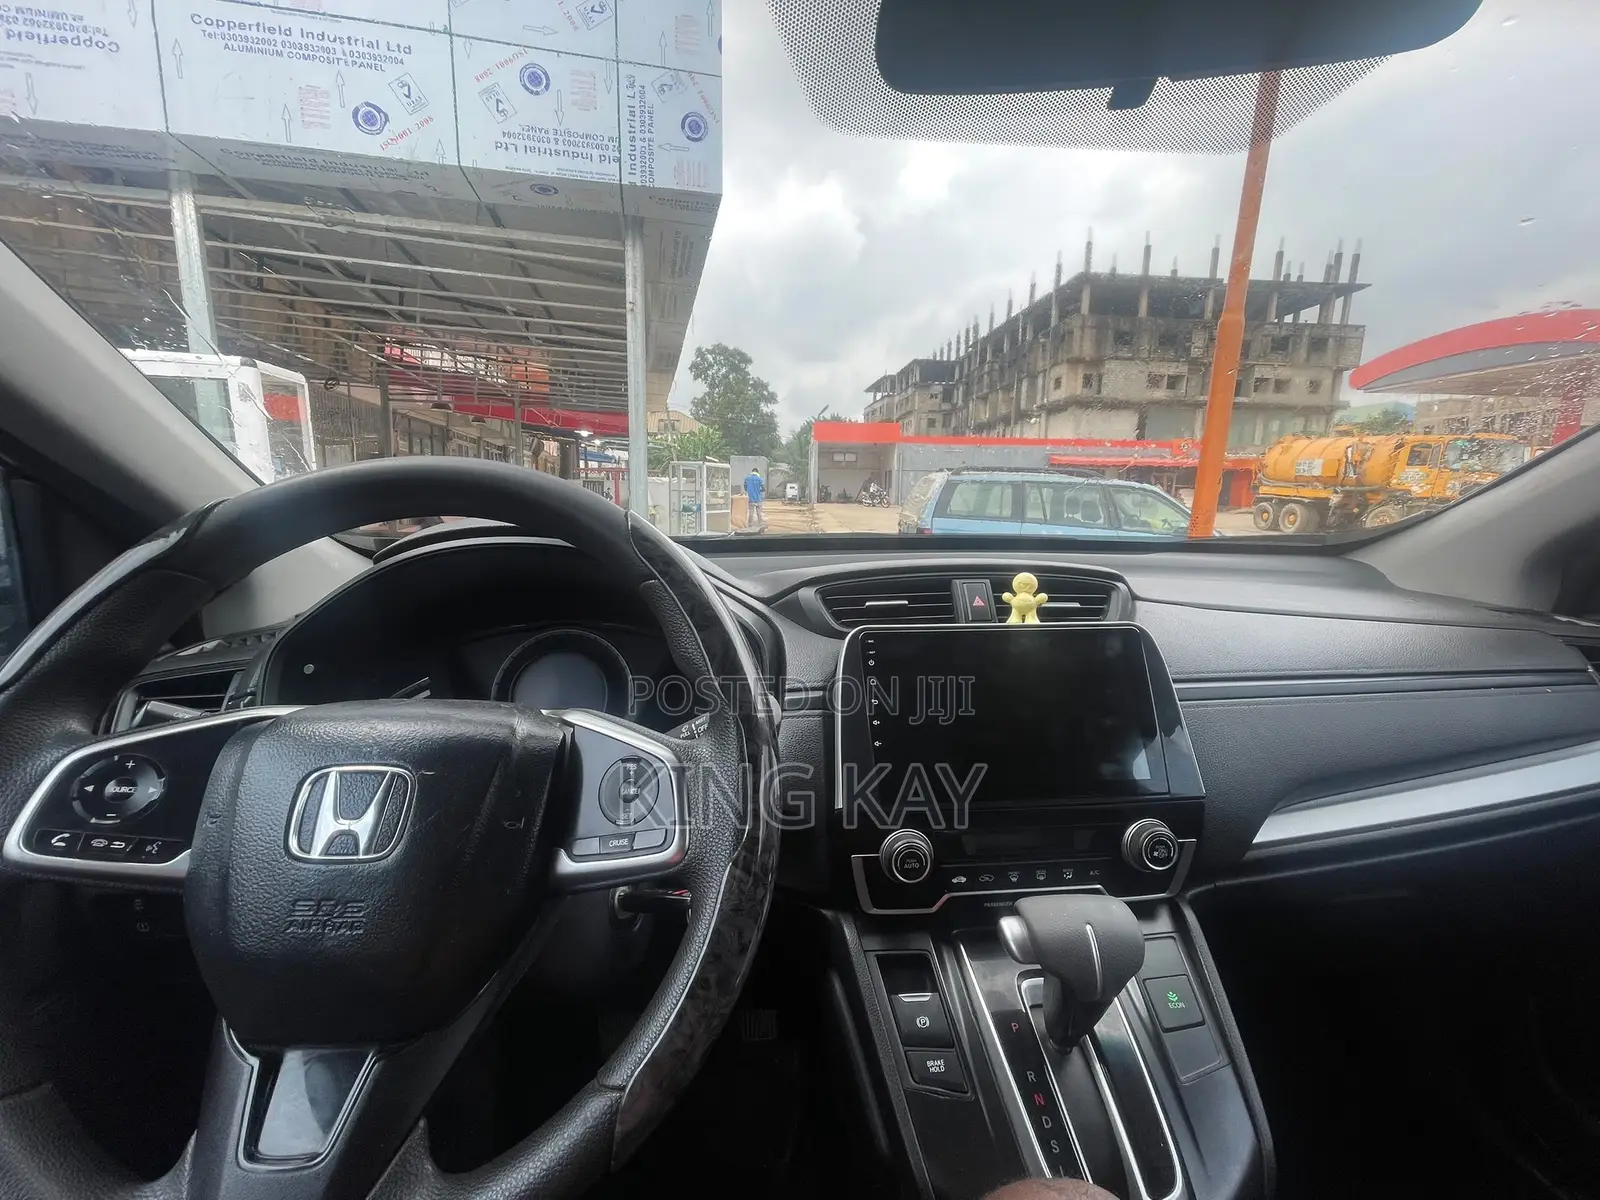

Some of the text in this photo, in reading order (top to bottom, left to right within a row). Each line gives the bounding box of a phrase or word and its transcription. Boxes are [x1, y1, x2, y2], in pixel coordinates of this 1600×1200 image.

[5, 28, 120, 53] Copperfield
[190, 13, 292, 37] Copperfield
[300, 27, 380, 50] Industrial
[386, 41, 412, 55] Ltd
[223, 43, 284, 58] ALUMINIUM
[287, 51, 350, 67] COMPOSITE
[351, 60, 386, 72] PANEL
[647, 103, 655, 135] PANEL
[552, 128, 605, 142] COMPOSITE
[627, 105, 637, 176] Industrial
[495, 140, 518, 154] Ltd
[524, 144, 593, 162] Industrial
[608, 838, 629, 848] CRUISE
[1011, 1022, 1019, 1033] P
[926, 1059, 945, 1067] BRAKE
[1026, 1070, 1037, 1083] R
[1034, 1093, 1046, 1106] N
[1042, 1115, 1052, 1129] D
[1050, 1139, 1060, 1154] S
